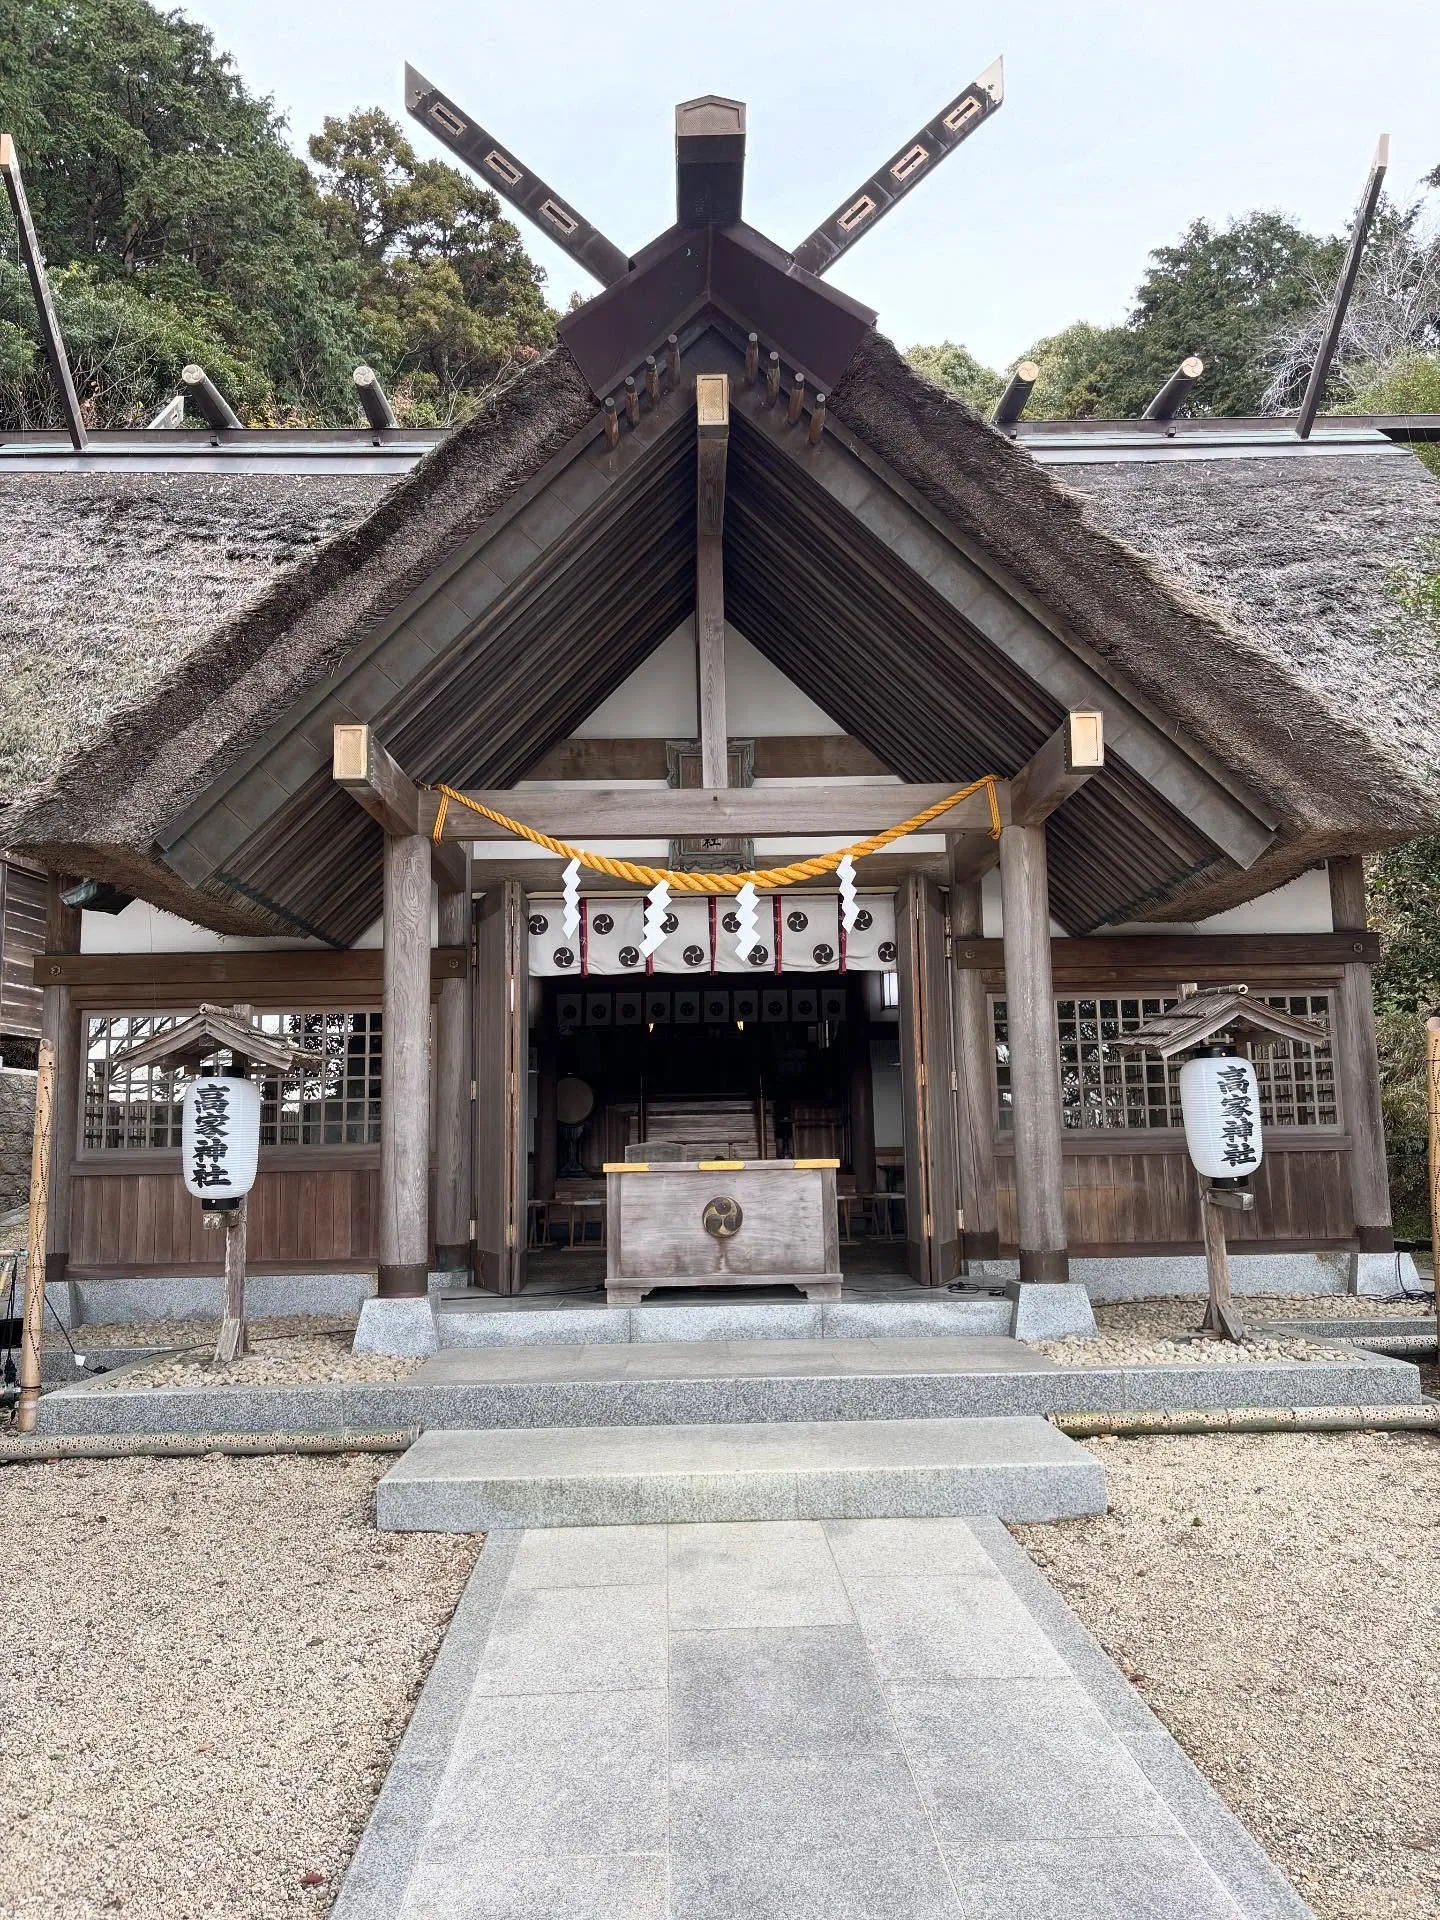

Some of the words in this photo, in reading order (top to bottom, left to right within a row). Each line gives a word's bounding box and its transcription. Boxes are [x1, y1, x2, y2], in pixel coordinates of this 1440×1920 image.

[190, 1083, 232, 1188] 高家神社
[1216, 1065, 1257, 1167] 高家神社
